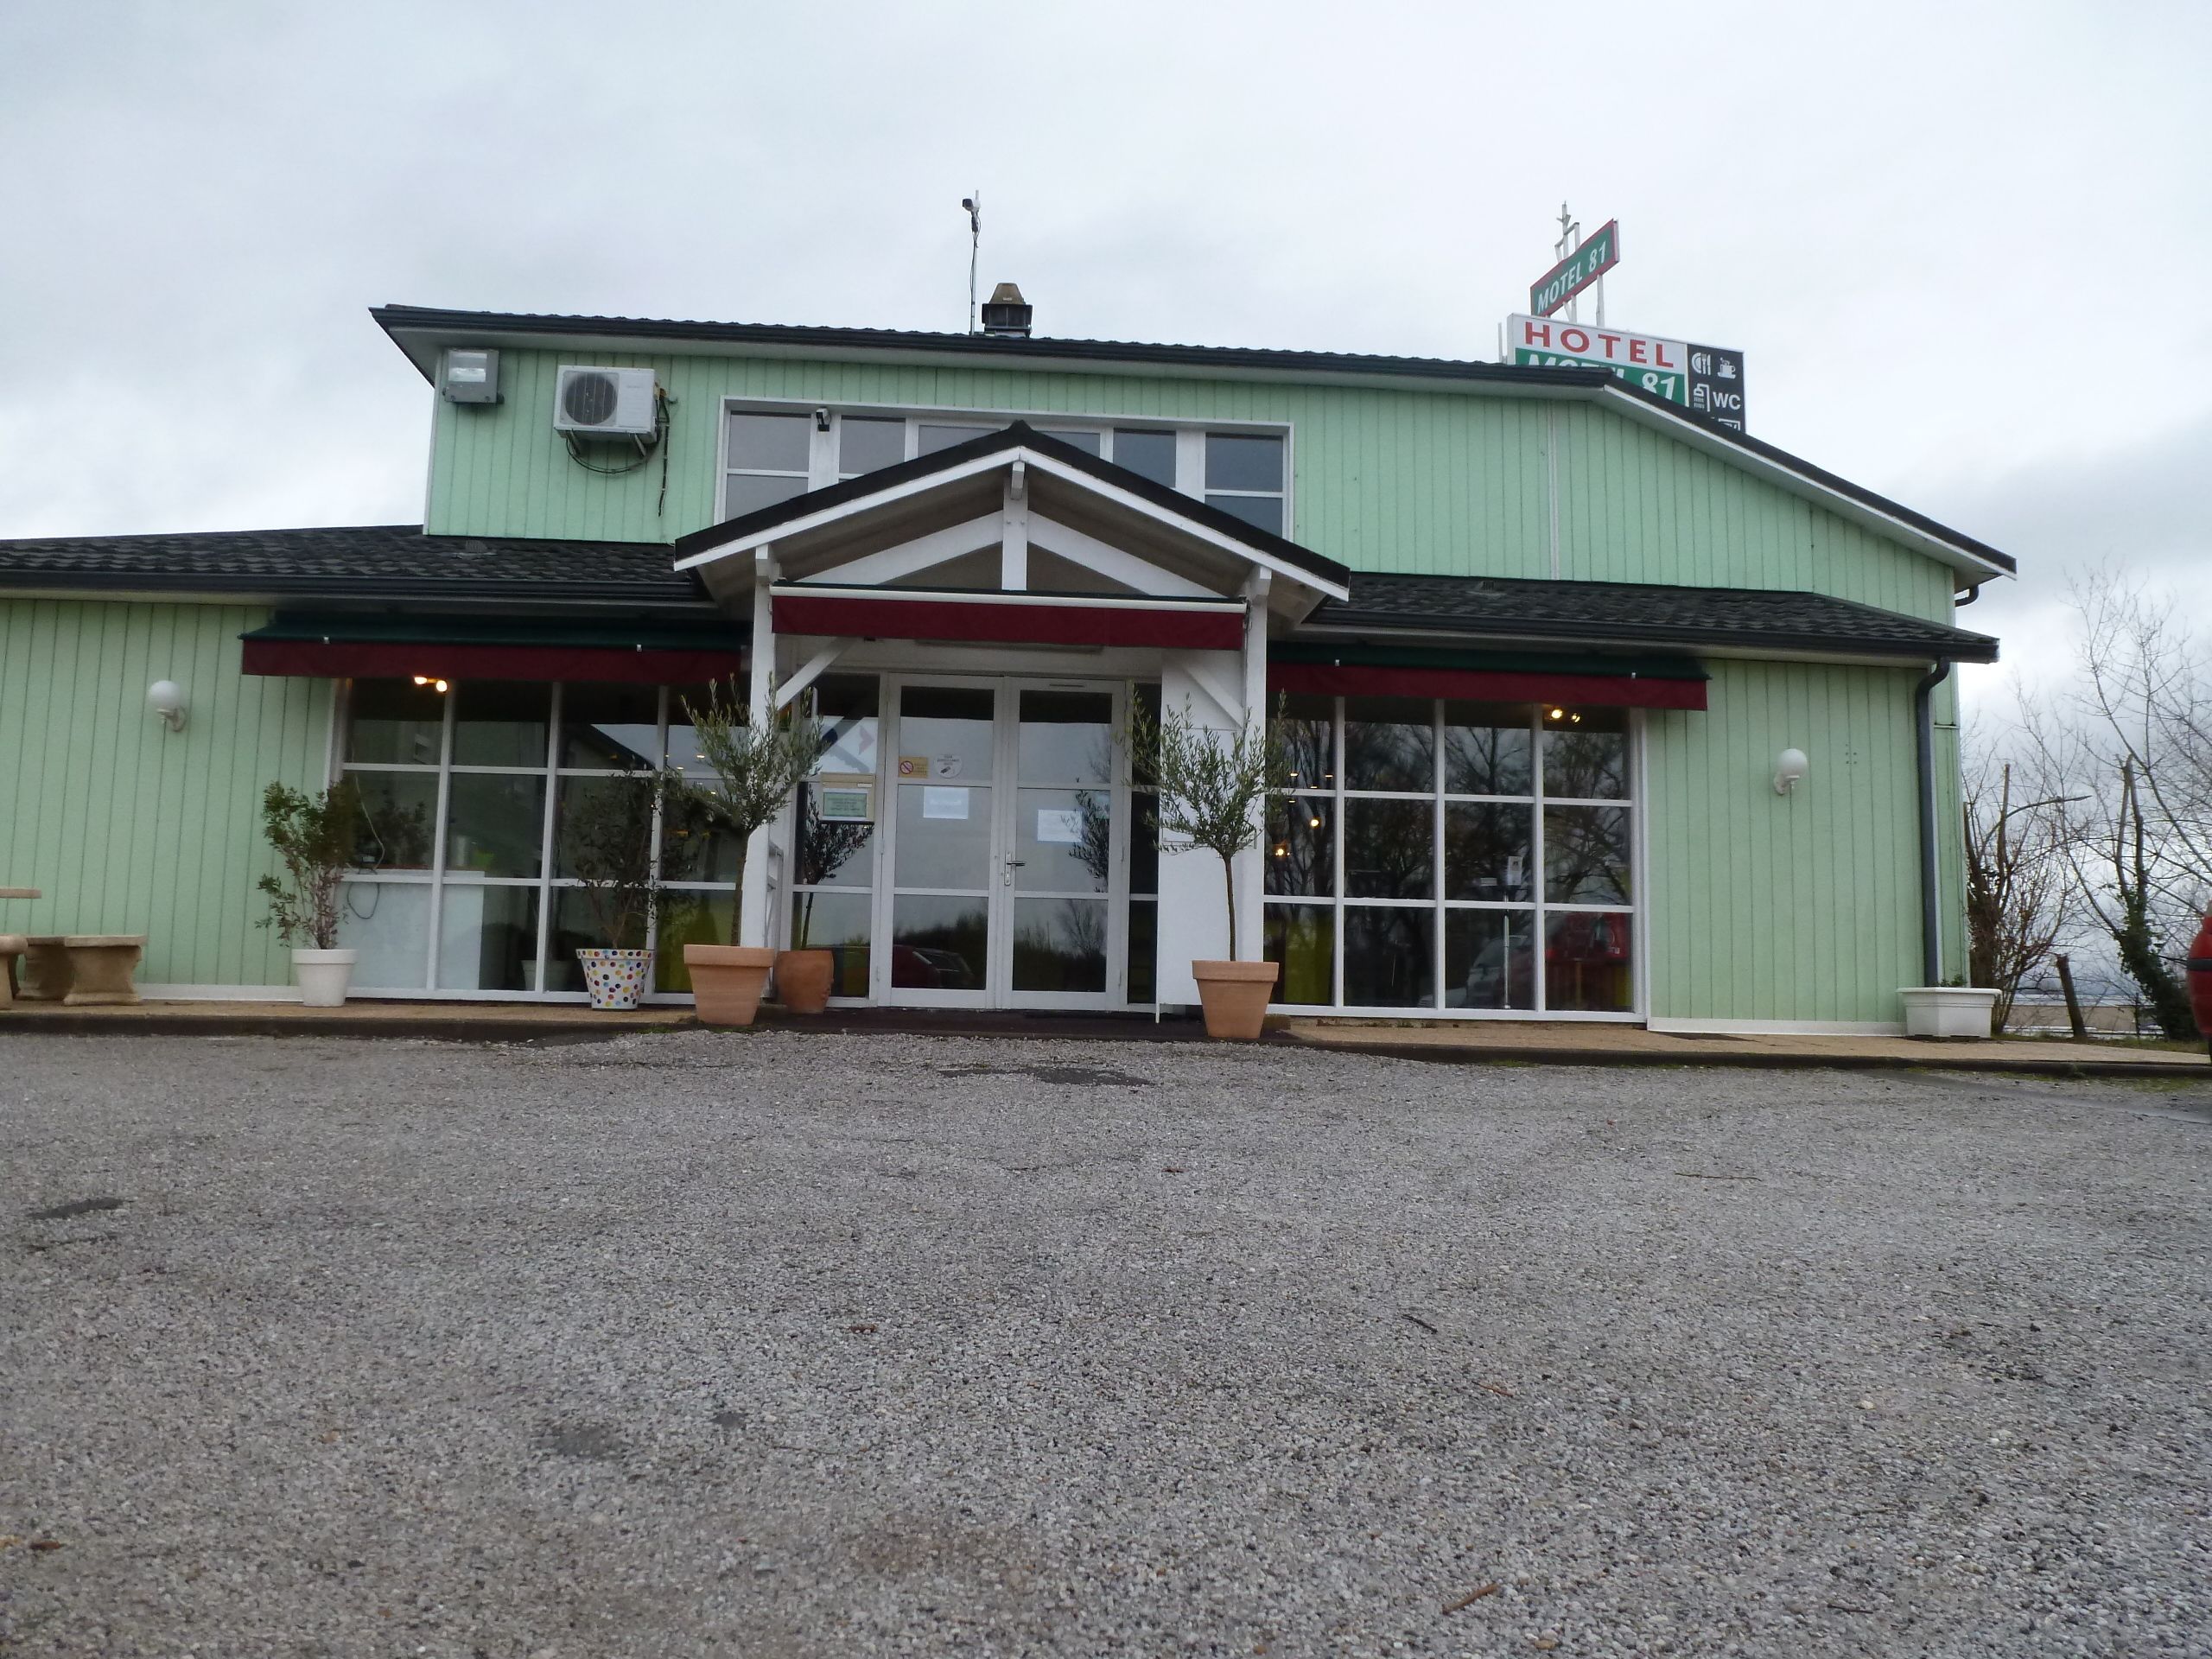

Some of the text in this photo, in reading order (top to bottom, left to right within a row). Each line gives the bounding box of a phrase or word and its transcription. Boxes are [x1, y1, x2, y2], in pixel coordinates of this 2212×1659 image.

[1537, 241, 1606, 314] MOTEL 81
[1525, 321, 1674, 368] HOTEL
[1713, 391, 1741, 410] WC
